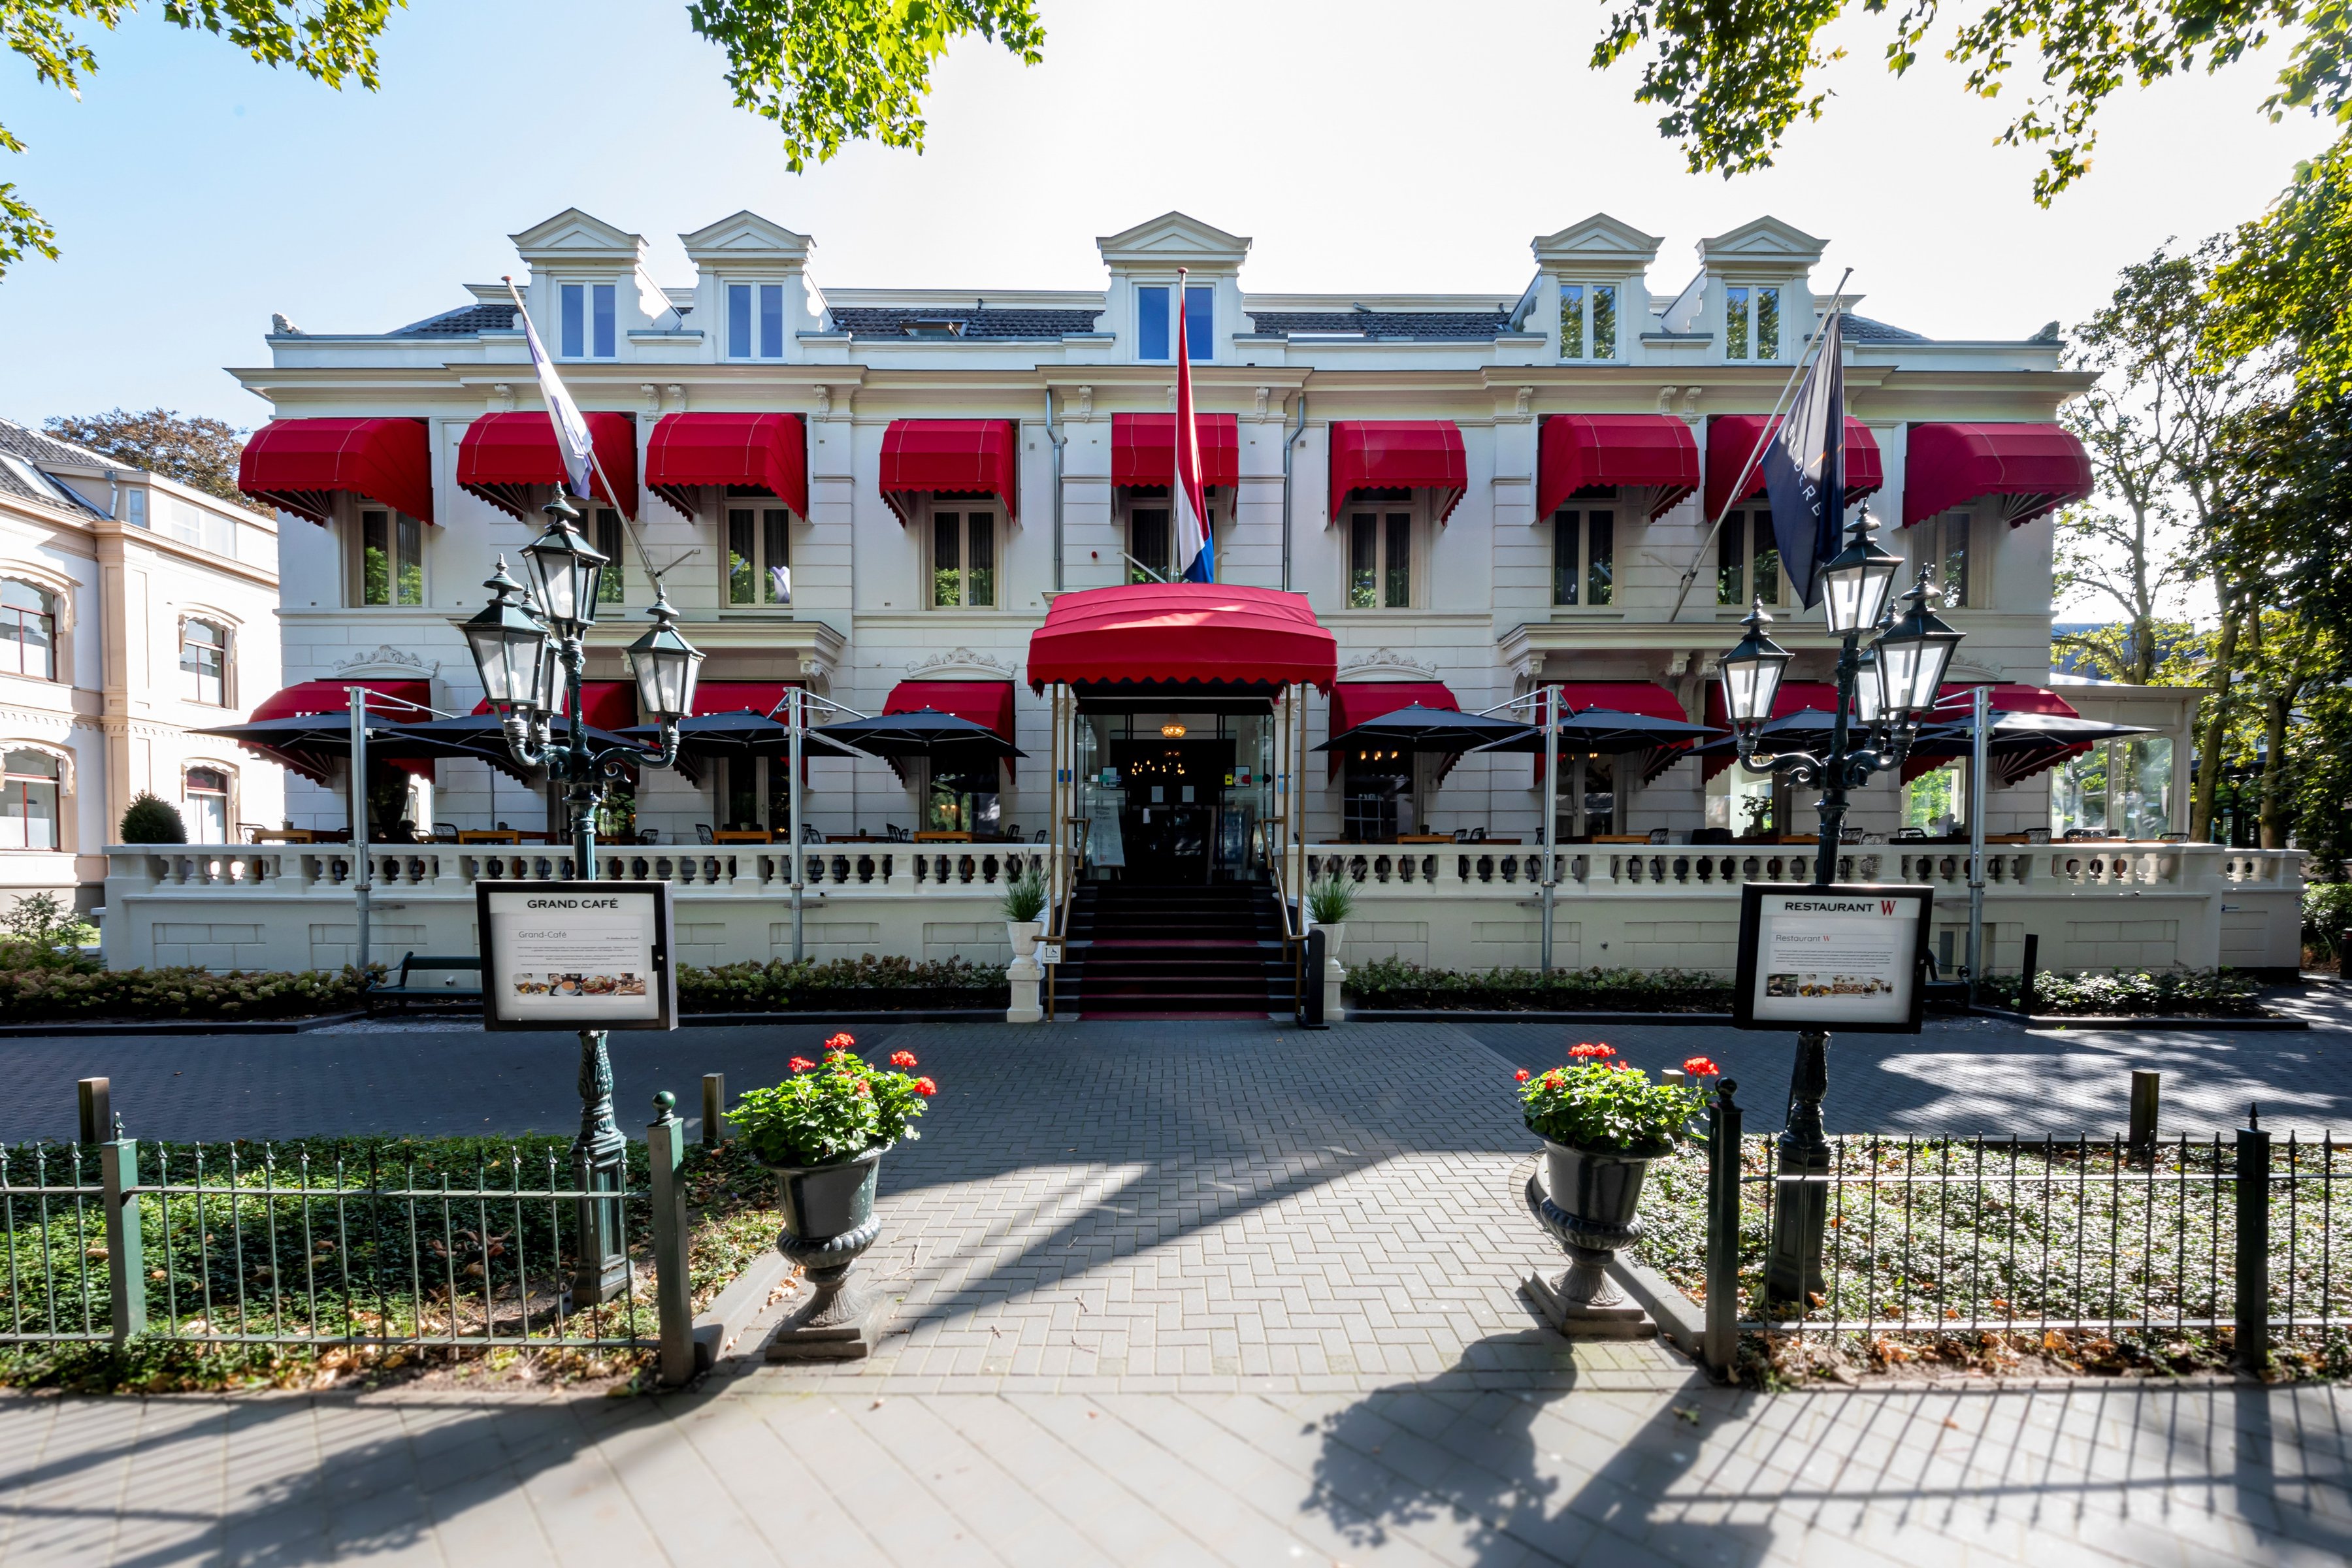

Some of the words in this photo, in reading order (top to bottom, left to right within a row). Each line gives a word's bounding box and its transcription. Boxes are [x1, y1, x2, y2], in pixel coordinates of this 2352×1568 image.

[527, 900, 578, 908] GRAND
[581, 898, 618, 908] CAFÉ
[1785, 902, 1874, 912] RESTAURANT
[1881, 900, 1896, 916] W
[518, 930, 566, 939] Grand-Café
